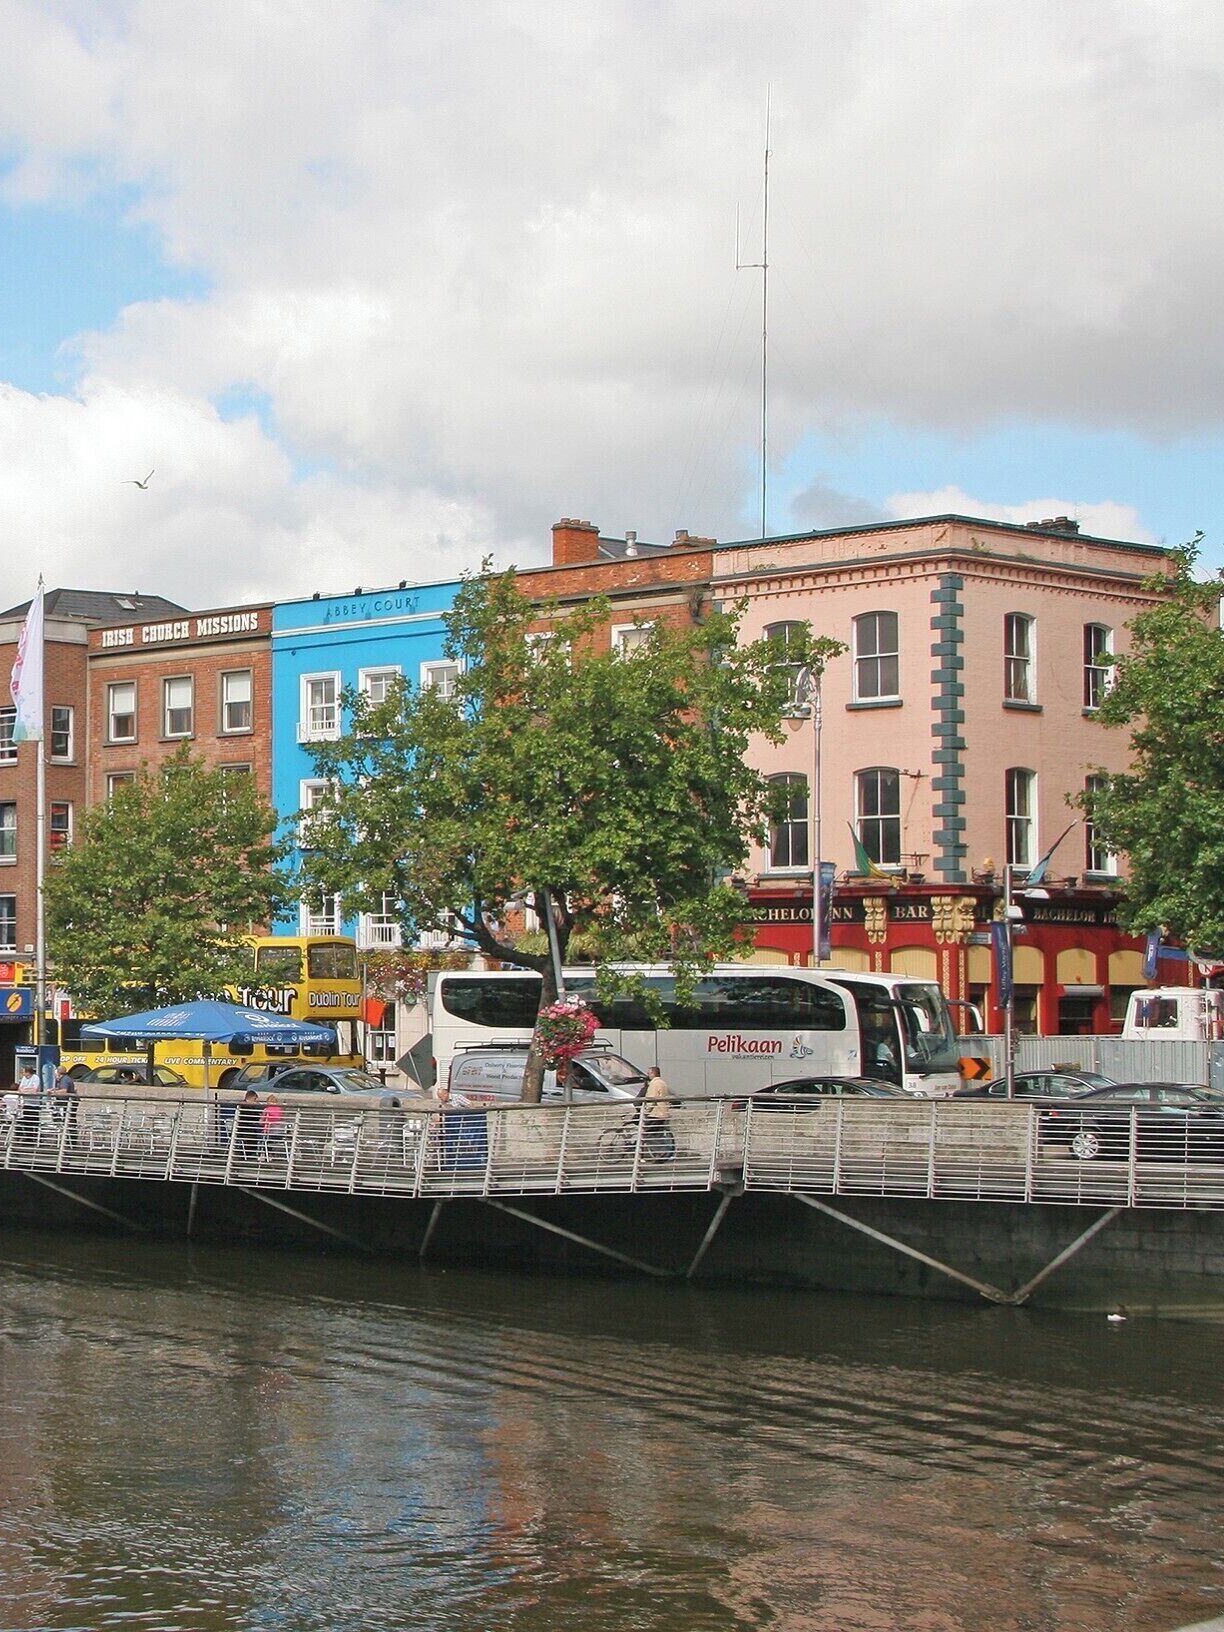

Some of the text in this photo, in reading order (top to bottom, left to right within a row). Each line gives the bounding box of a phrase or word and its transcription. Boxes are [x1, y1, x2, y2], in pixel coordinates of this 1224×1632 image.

[326, 597, 421, 618] ABBEY COURT
[101, 612, 258, 648] IRISH CHURCH MISSIONS
[895, 906, 928, 919] BAR
[1033, 909, 1096, 922] BACHELOR
[308, 991, 361, 1008] Dublin Tour
[707, 1035, 782, 1053] Pelikaan
[164, 1057, 181, 1065] LIVE
